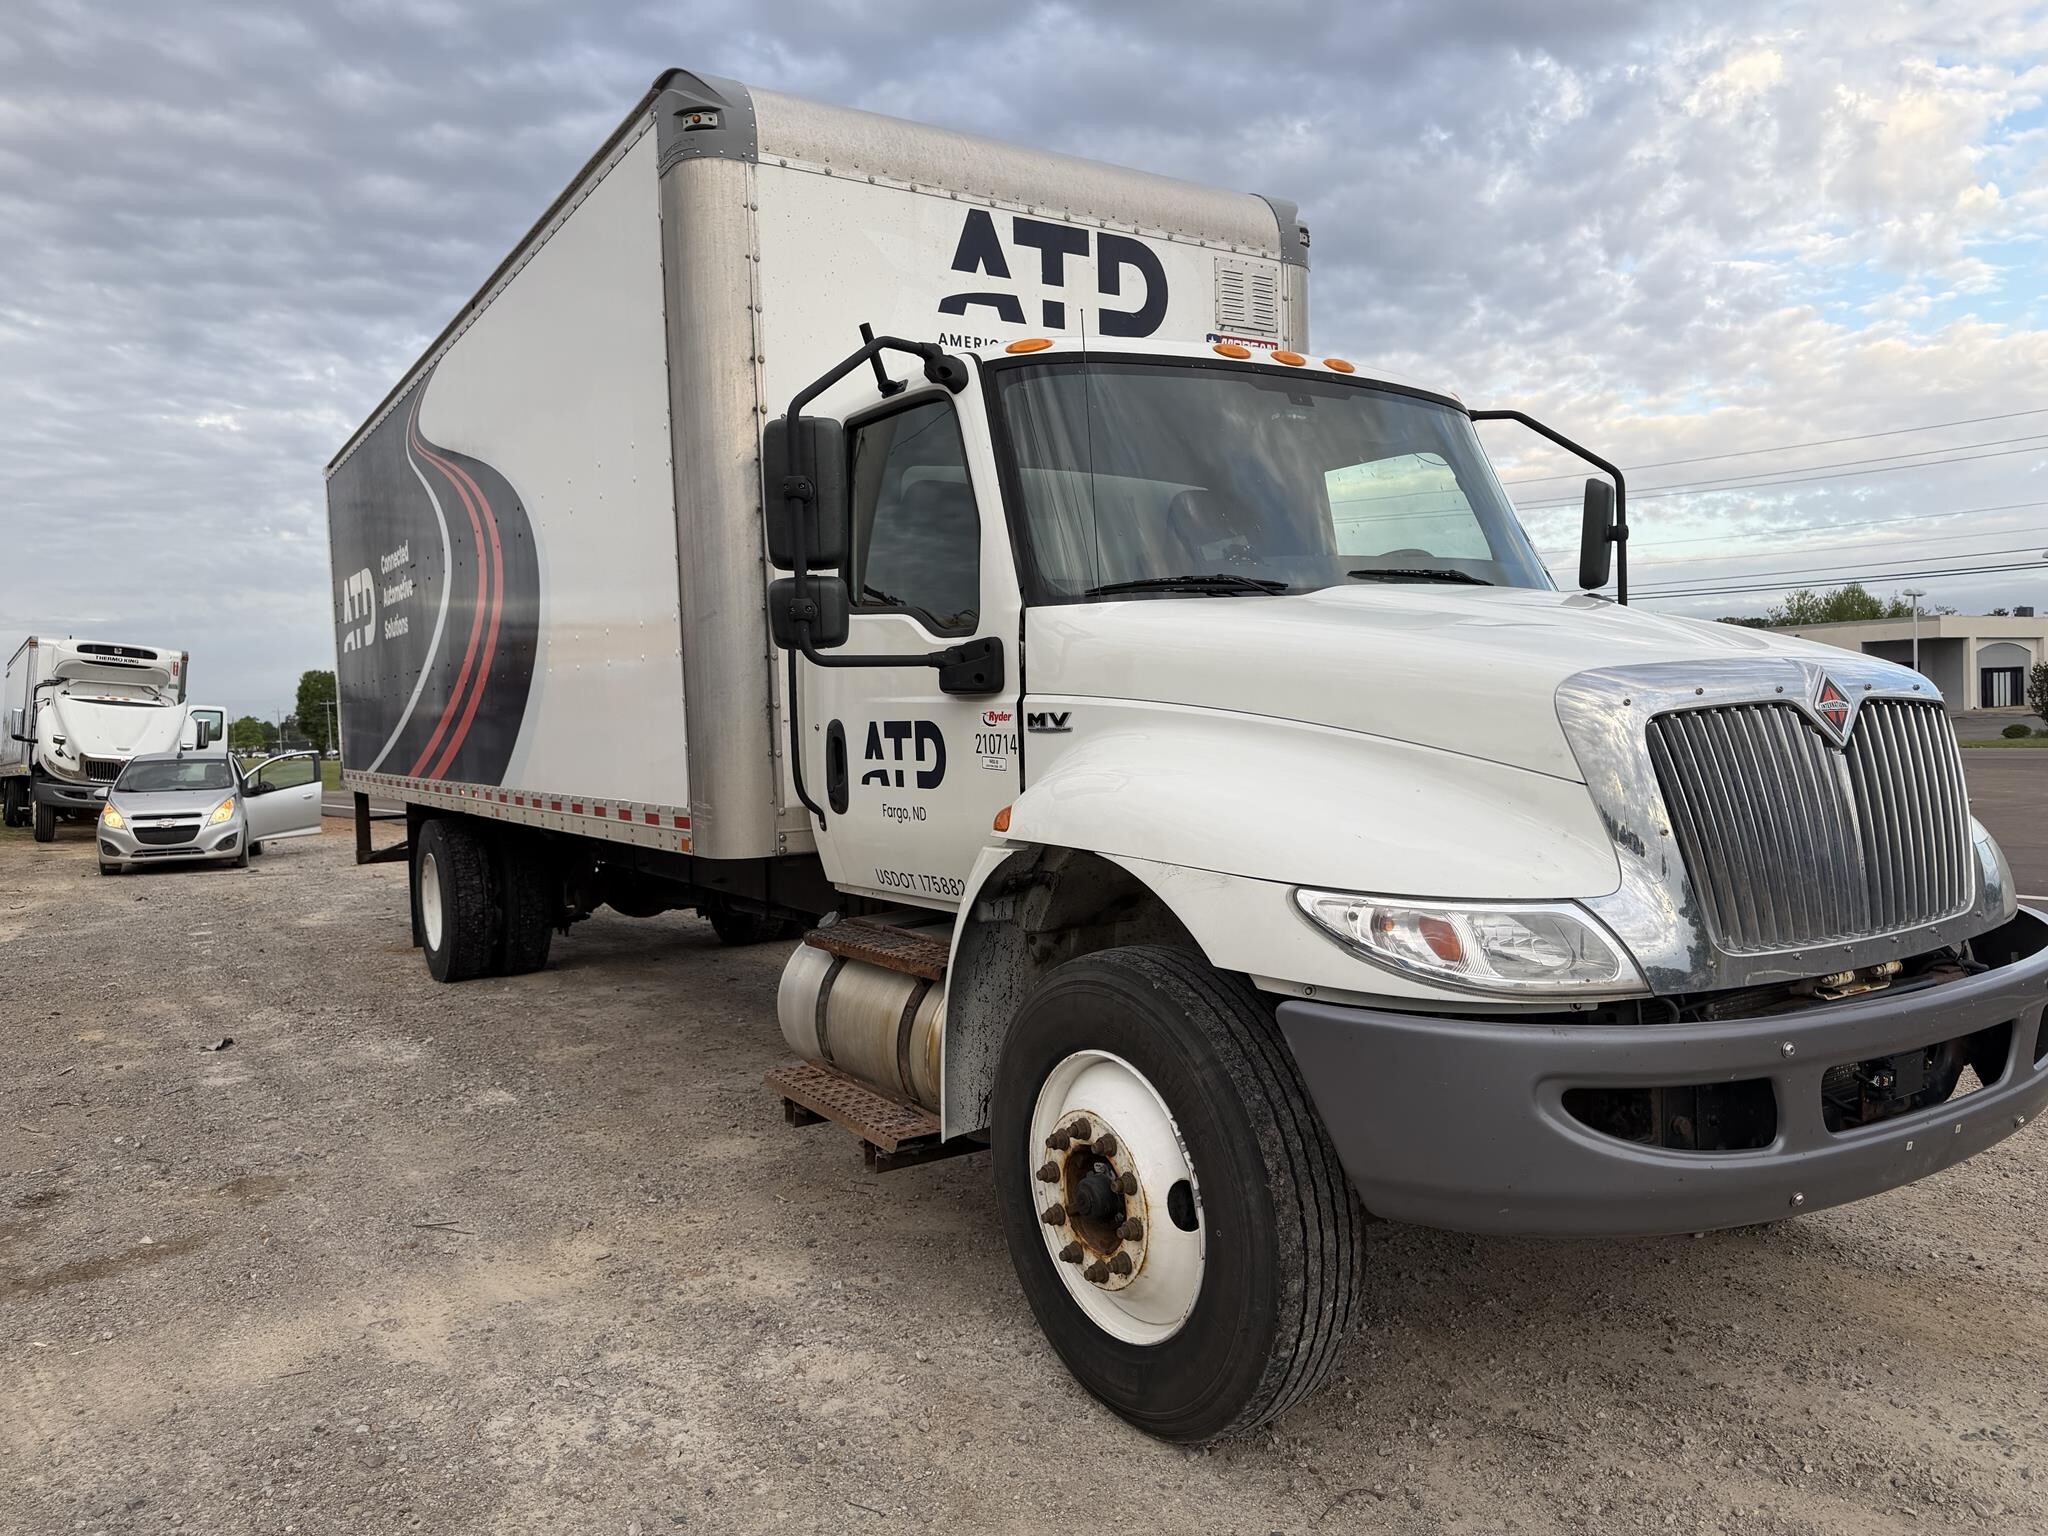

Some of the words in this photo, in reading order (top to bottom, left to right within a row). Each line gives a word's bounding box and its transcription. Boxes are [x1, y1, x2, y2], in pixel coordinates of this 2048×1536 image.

[937, 207, 1169, 338] ATD
[381, 539, 409, 575] Connected
[383, 575, 413, 607] Automotive
[343, 567, 376, 653] ATD
[385, 613, 409, 640] Solutions
[96, 655, 123, 663] THERMO
[988, 711, 1013, 723] Ryder
[1027, 712, 1072, 727] MV
[861, 720, 947, 789] ATD
[975, 733, 1018, 755] 210714
[882, 803, 911, 824] Fargo,
[912, 806, 927, 821] ND
[875, 868, 916, 890] USDOT
